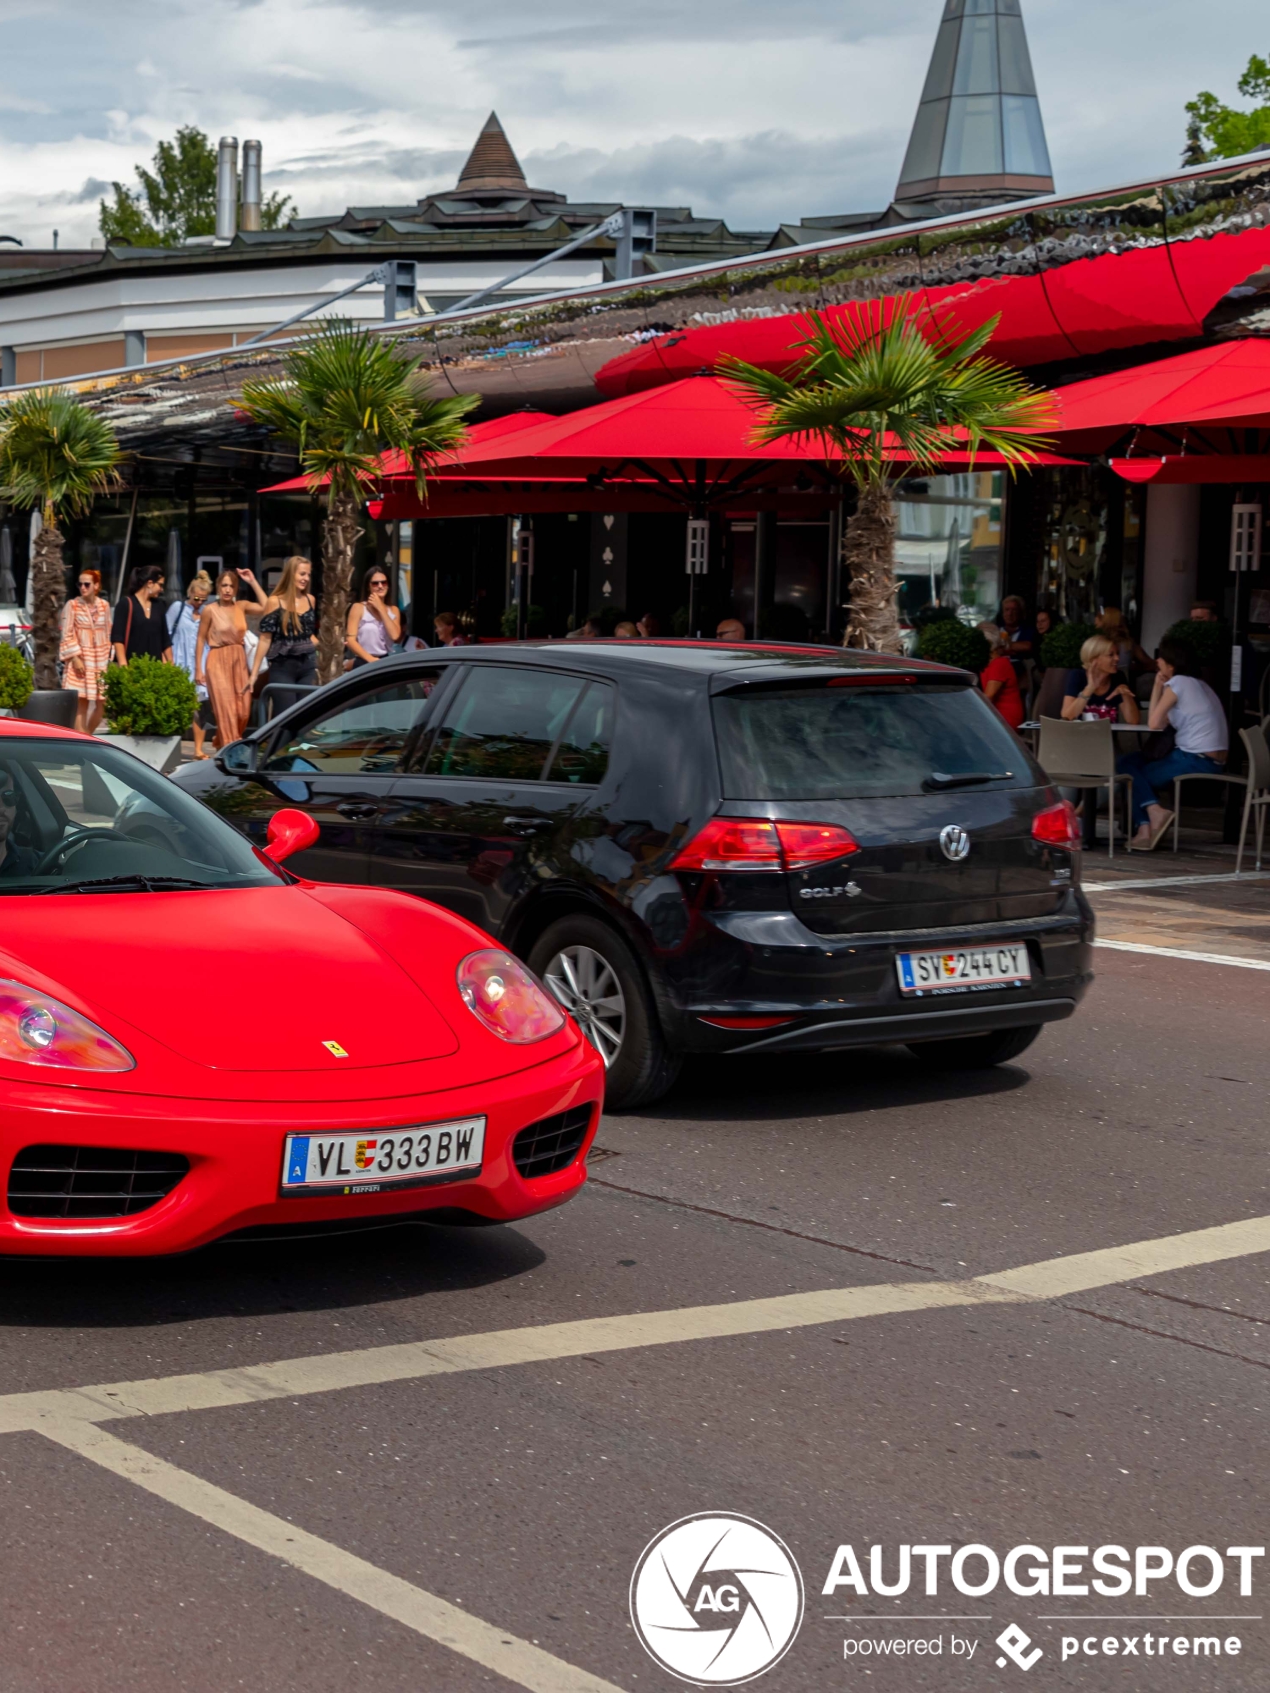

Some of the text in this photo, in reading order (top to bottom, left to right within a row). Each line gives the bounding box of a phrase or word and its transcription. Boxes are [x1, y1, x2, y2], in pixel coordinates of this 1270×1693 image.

[799, 887, 843, 898] GOLF
[918, 947, 1019, 982] SV 244 CY
[317, 1141, 352, 1177] VL
